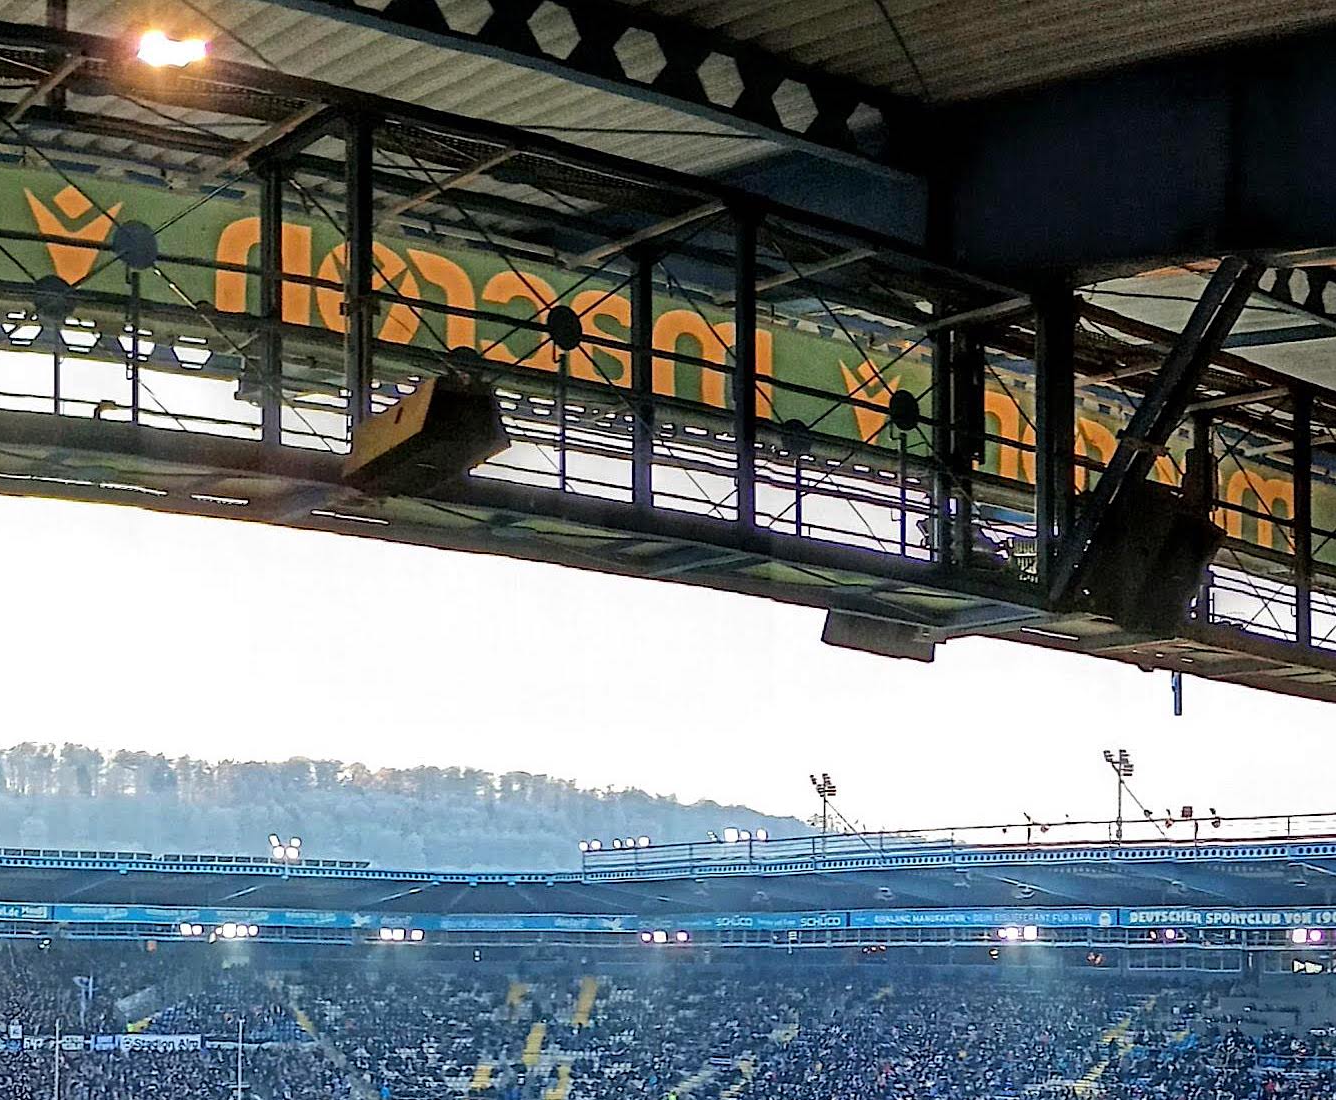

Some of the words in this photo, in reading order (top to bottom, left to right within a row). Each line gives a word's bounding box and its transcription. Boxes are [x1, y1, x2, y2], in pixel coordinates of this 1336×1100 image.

[715, 915, 753, 927] SCHÜCO
[800, 913, 841, 927] SCHÜCO
[1130, 910, 1201, 924] DEUTSCHER
[1205, 911, 1281, 924] SPORTCLUB
[1283, 911, 1312, 924] VON
[135, 1038, 175, 1051] Stadion
